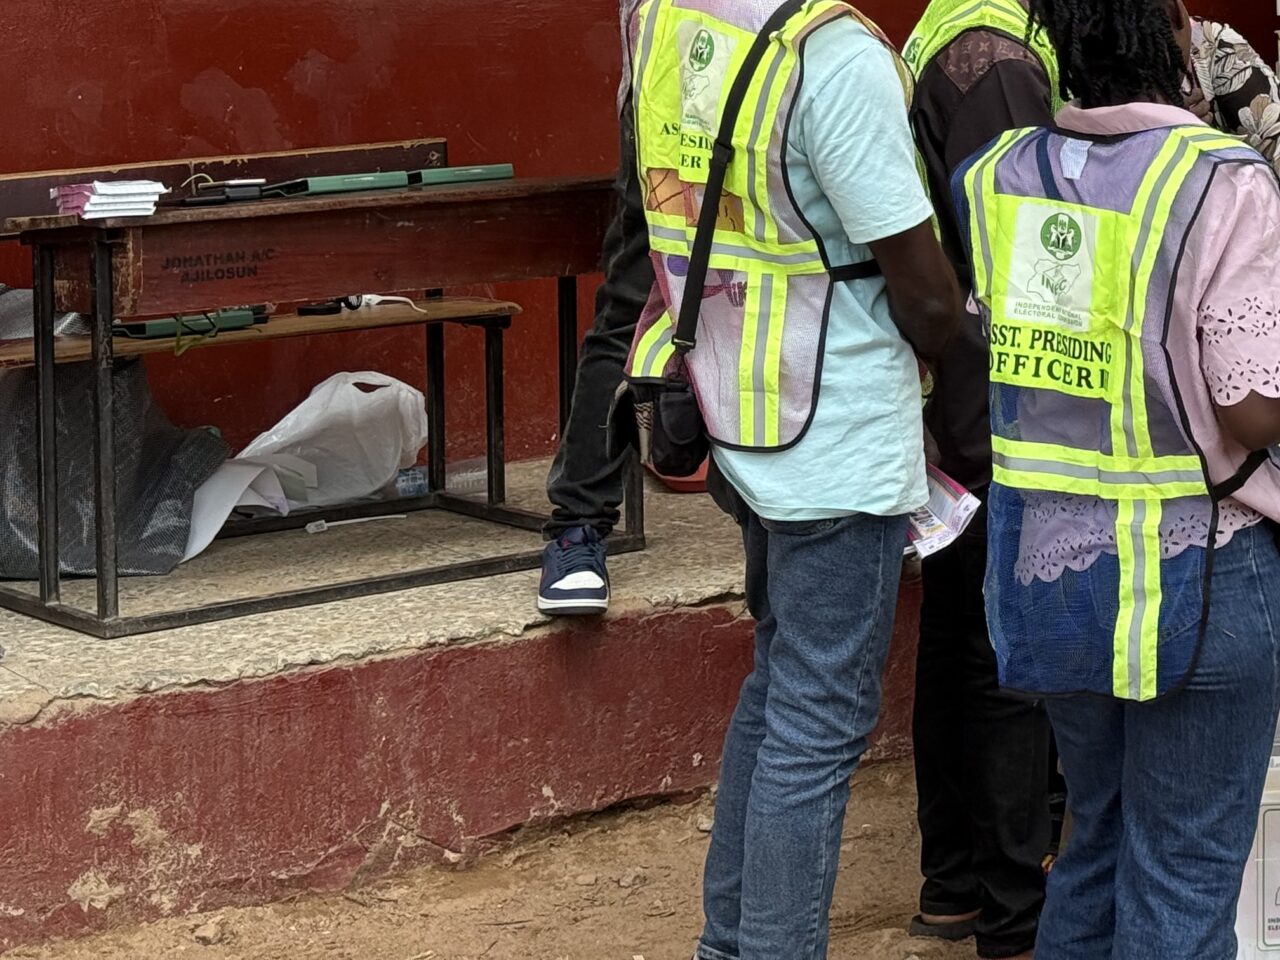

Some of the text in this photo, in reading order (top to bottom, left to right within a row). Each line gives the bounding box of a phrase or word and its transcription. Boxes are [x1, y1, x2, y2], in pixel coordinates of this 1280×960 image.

[180, 265, 258, 283] AJILOSUN
[990, 323, 1112, 364] SST. PRESIDING
[989, 350, 1094, 389] FFICER
